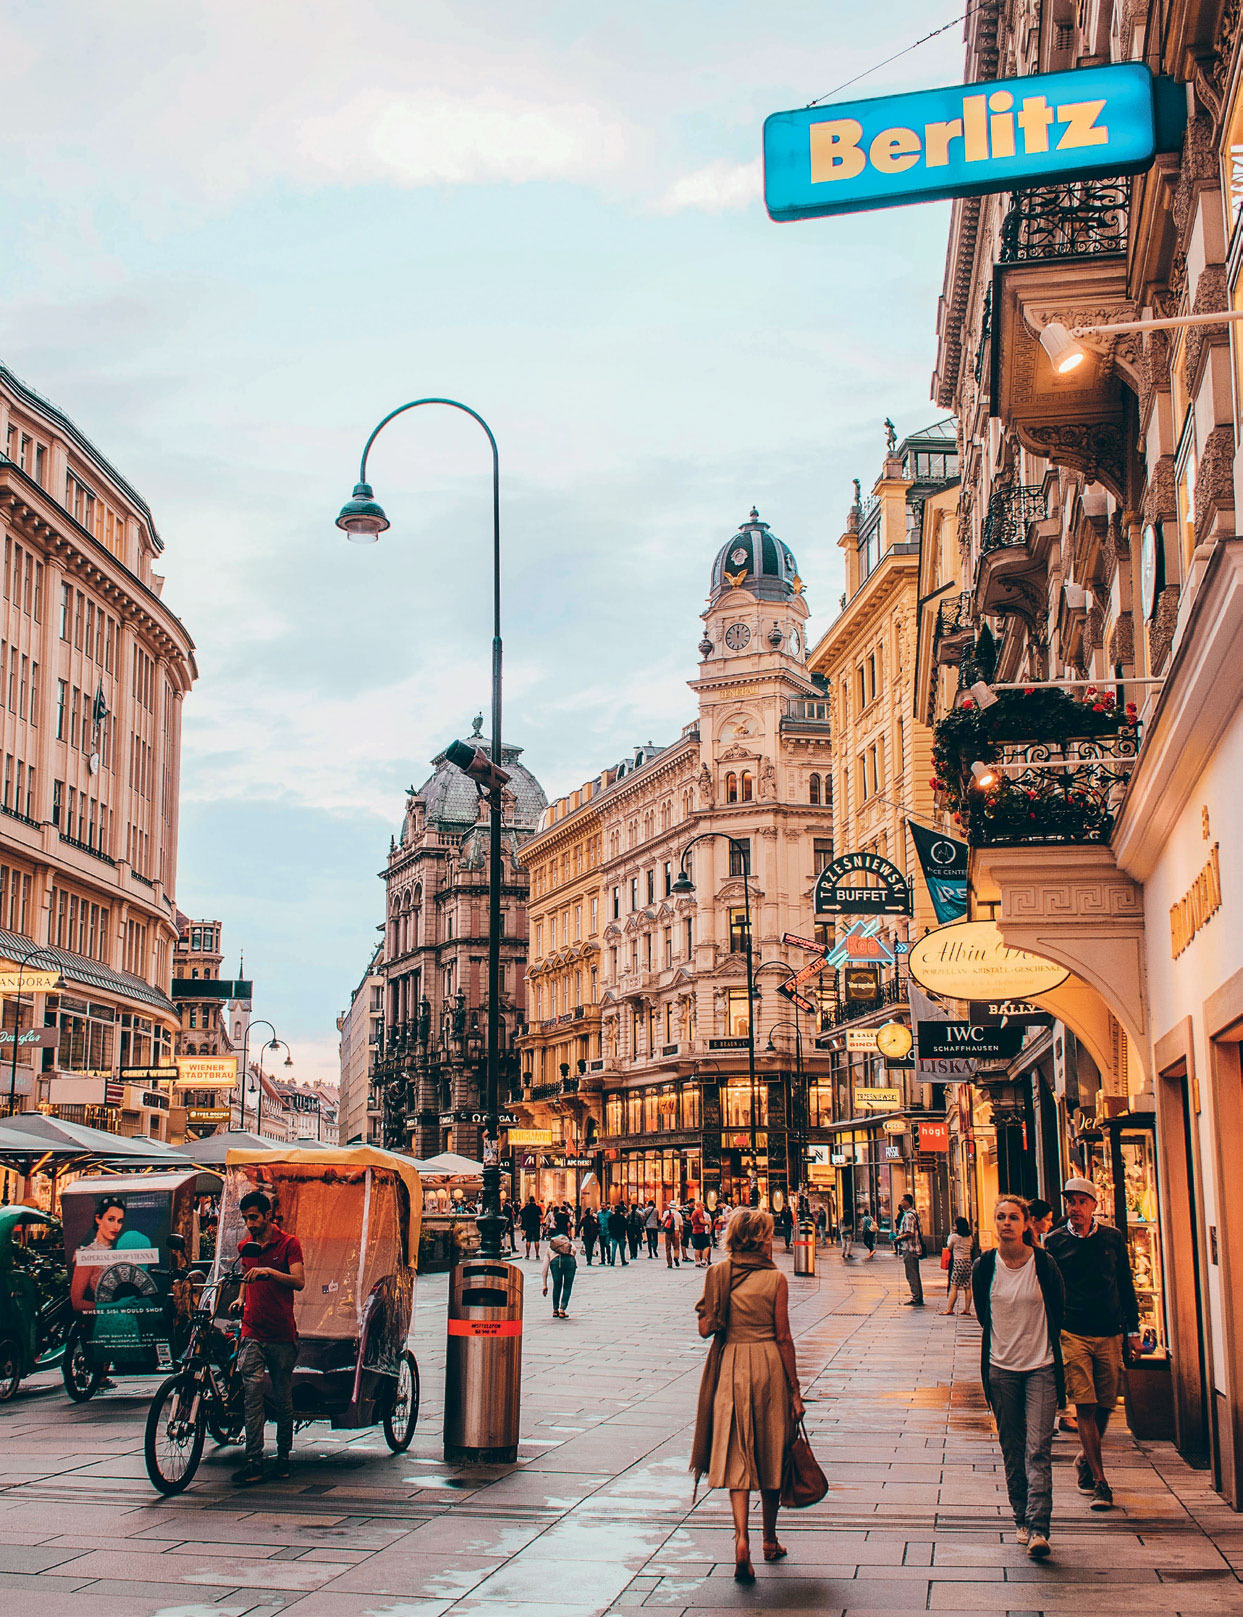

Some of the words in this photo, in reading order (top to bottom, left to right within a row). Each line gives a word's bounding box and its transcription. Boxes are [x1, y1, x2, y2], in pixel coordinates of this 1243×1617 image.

[810, 90, 1109, 184] Berlitz
[836, 890, 888, 901] BUFFET
[988, 1004, 1036, 1015] BALLY
[946, 1026, 985, 1042] IWC
[919, 1059, 975, 1074] LISKA
